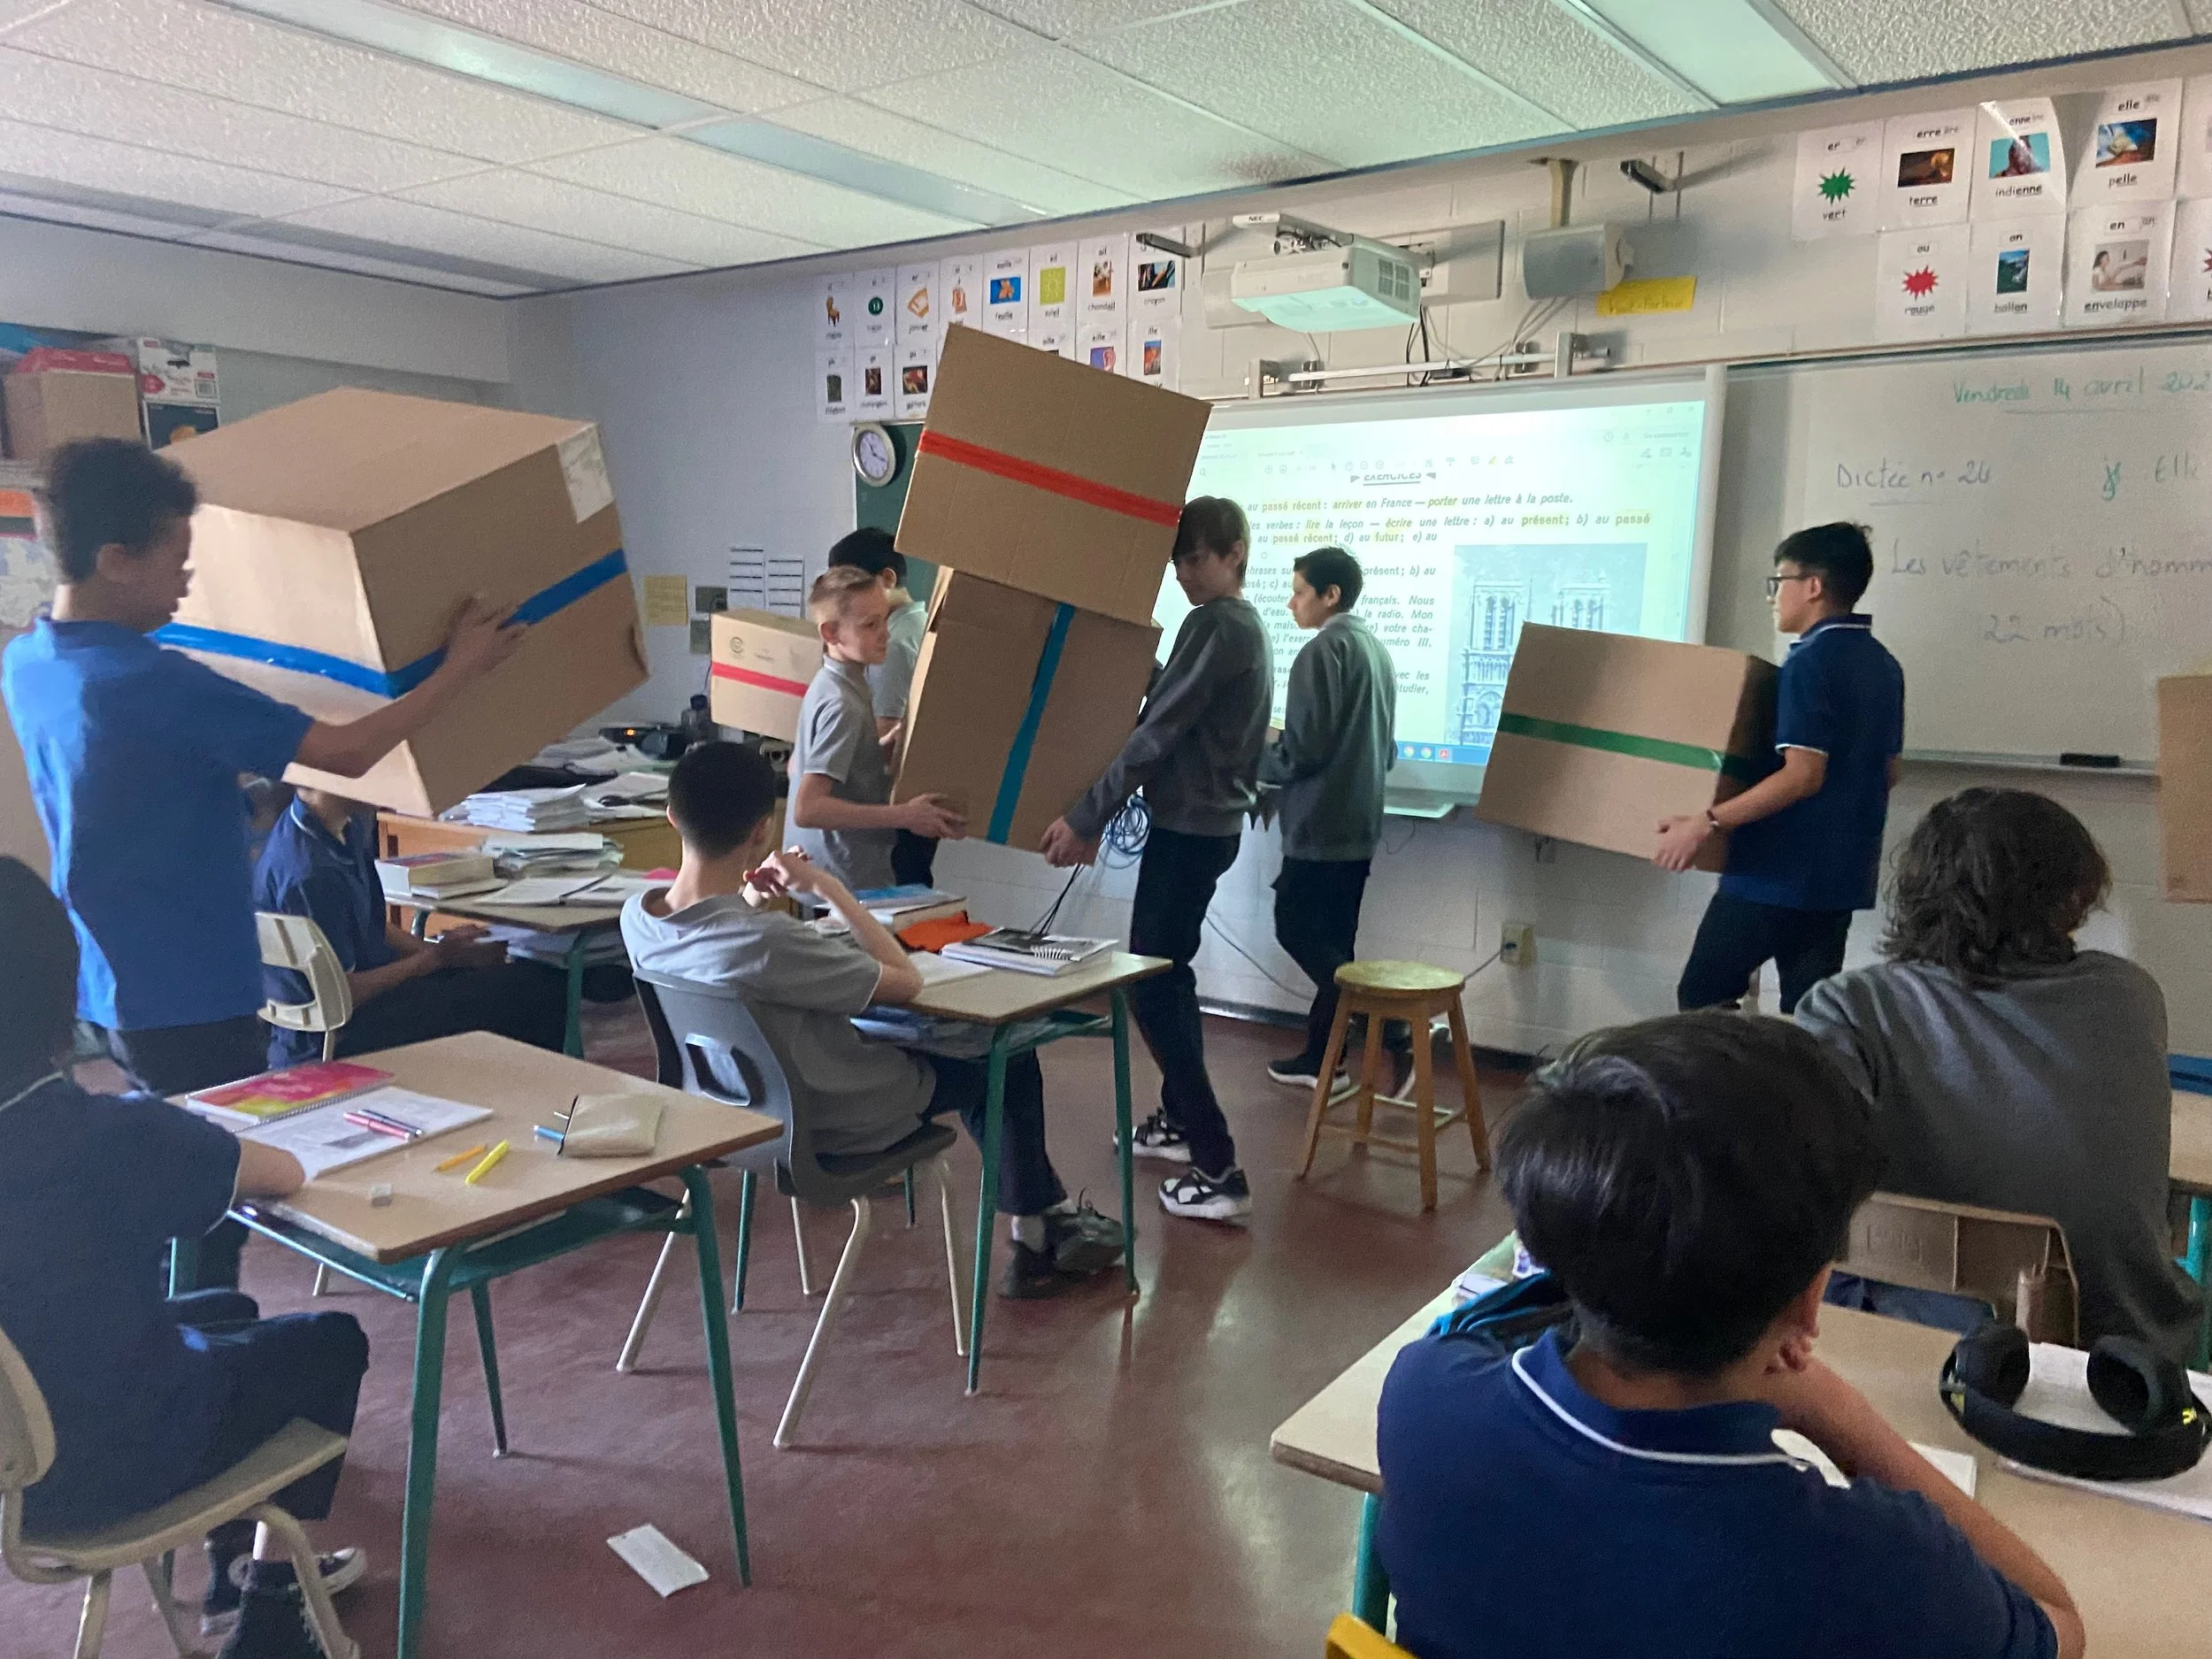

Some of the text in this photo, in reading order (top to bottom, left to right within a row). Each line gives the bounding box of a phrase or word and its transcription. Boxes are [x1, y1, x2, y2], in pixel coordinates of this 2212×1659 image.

[2118, 99, 2140, 111] elle
[2009, 115, 2032, 126] enne
[1916, 129, 1941, 138] erre
[1827, 142, 1840, 150] er
[2108, 173, 2138, 188] pelle
[1995, 184, 2042, 197] indienne
[1909, 196, 1938, 205] terre
[1823, 209, 1846, 219] vert
[2084, 298, 2147, 311] enveloppe
[1838, 457, 1909, 488] Dictée
[1263, 501, 1288, 513] passé
[1333, 501, 1363, 510] arriver
[1381, 498, 1413, 508] France
[1427, 496, 1458, 509] porter
[1462, 496, 1480, 505] une
[1485, 495, 1511, 505] lettre
[1516, 494, 1523, 504] à
[1527, 493, 1537, 503] la
[1540, 493, 1573, 505] poste.
[1306, 519, 1321, 529] lire
[1325, 519, 1334, 529] la
[1340, 518, 1364, 531] leçon
[1386, 518, 1413, 528] écrire
[1419, 518, 1438, 527] une
[1484, 515, 1495, 527] a)
[1501, 517, 1515, 526] au
[1577, 513, 1589, 526] b)
[1595, 515, 1610, 525] au
[1616, 512, 1651, 526] passé
[1272, 533, 1299, 546] passé
[1344, 532, 1355, 544] d)
[1359, 534, 1371, 542] au
[1412, 533, 1423, 543] e)
[1425, 532, 1439, 541] au
[1409, 565, 1420, 577] b)
[1424, 567, 1437, 576] au
[1270, 578, 1279, 591] c)
[1361, 595, 1401, 606] français.
[1409, 595, 1435, 605] Nous
[1263, 607, 1288, 617] d'eau.
[1364, 609, 1373, 618] la
[1378, 609, 1405, 619] radio.
[1410, 610, 1434, 619] Mon
[1384, 623, 1408, 633] votre
[1412, 623, 1433, 634] cha-
[1416, 670, 1431, 680] les
